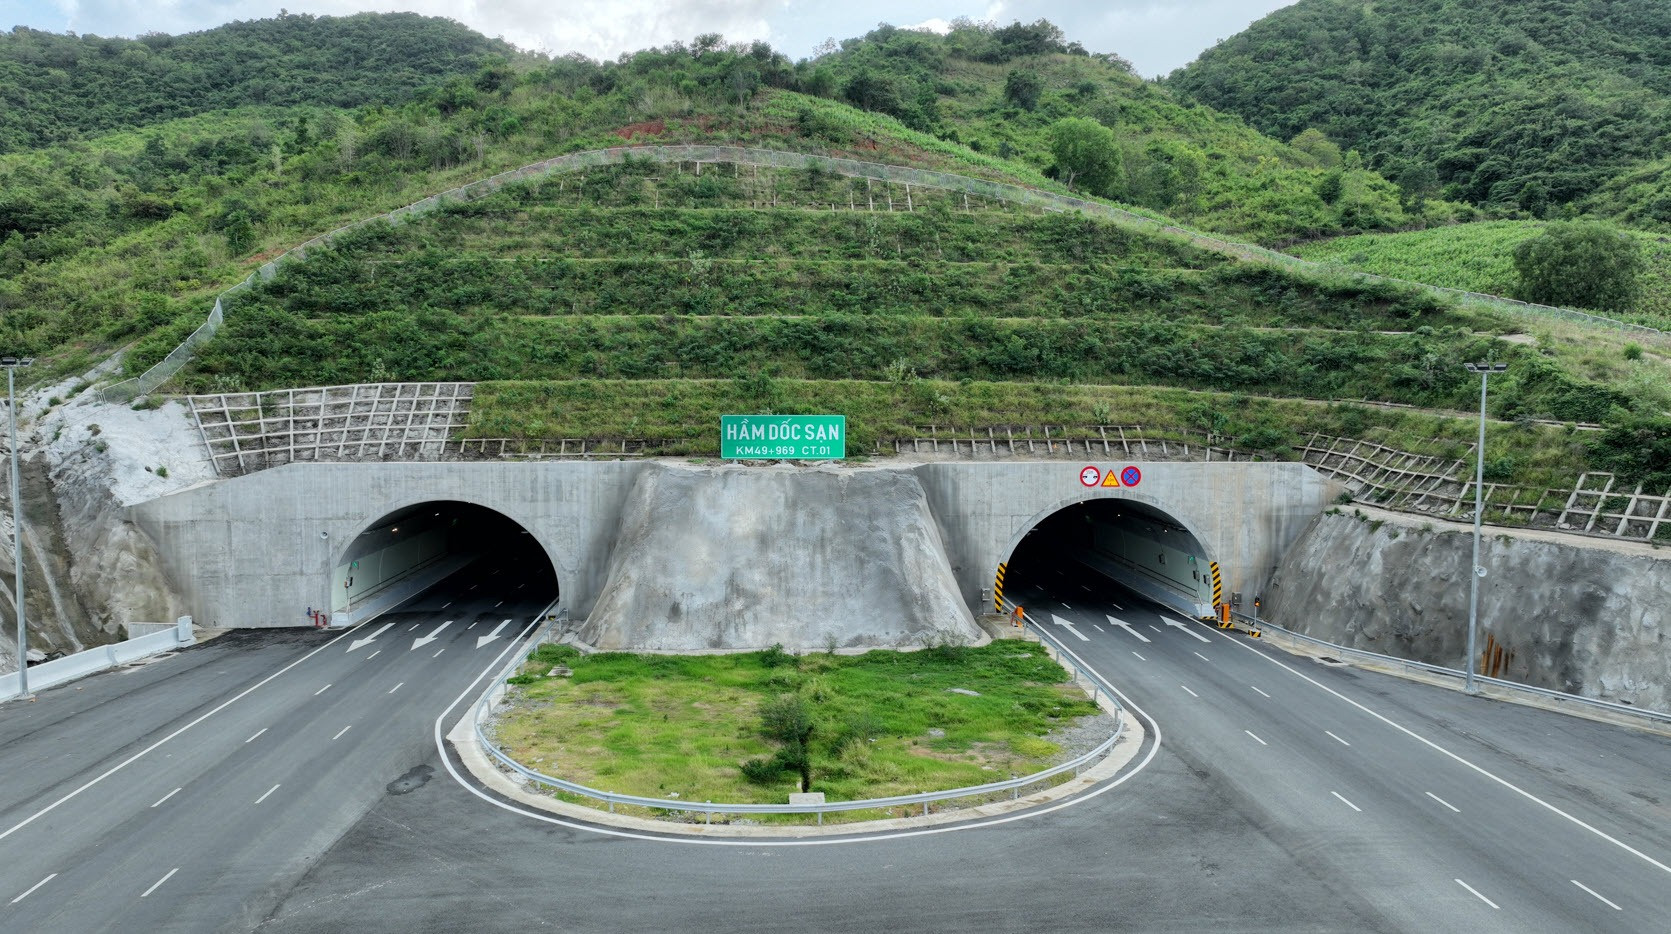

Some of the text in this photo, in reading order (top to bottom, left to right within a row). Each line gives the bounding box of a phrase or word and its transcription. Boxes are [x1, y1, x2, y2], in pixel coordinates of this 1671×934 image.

[727, 418, 839, 443] HẦM DỐC SẠN
[736, 446, 831, 455] KM49+969 CT.01
